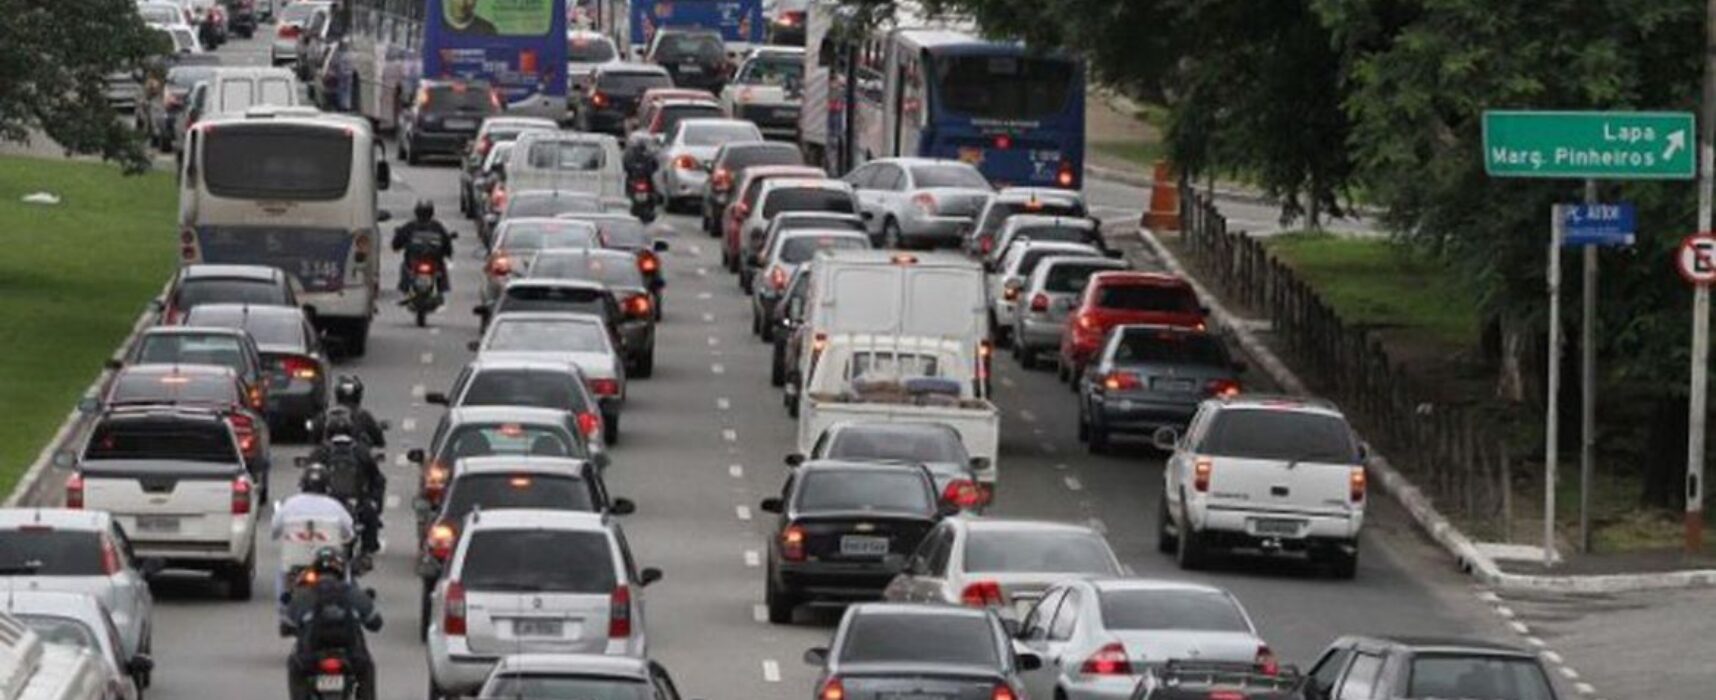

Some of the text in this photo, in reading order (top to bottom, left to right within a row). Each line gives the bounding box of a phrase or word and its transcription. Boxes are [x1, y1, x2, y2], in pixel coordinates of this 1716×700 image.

[1604, 123, 1655, 142] Lapa
[1492, 147, 1655, 169] Marg. Pinheiros
